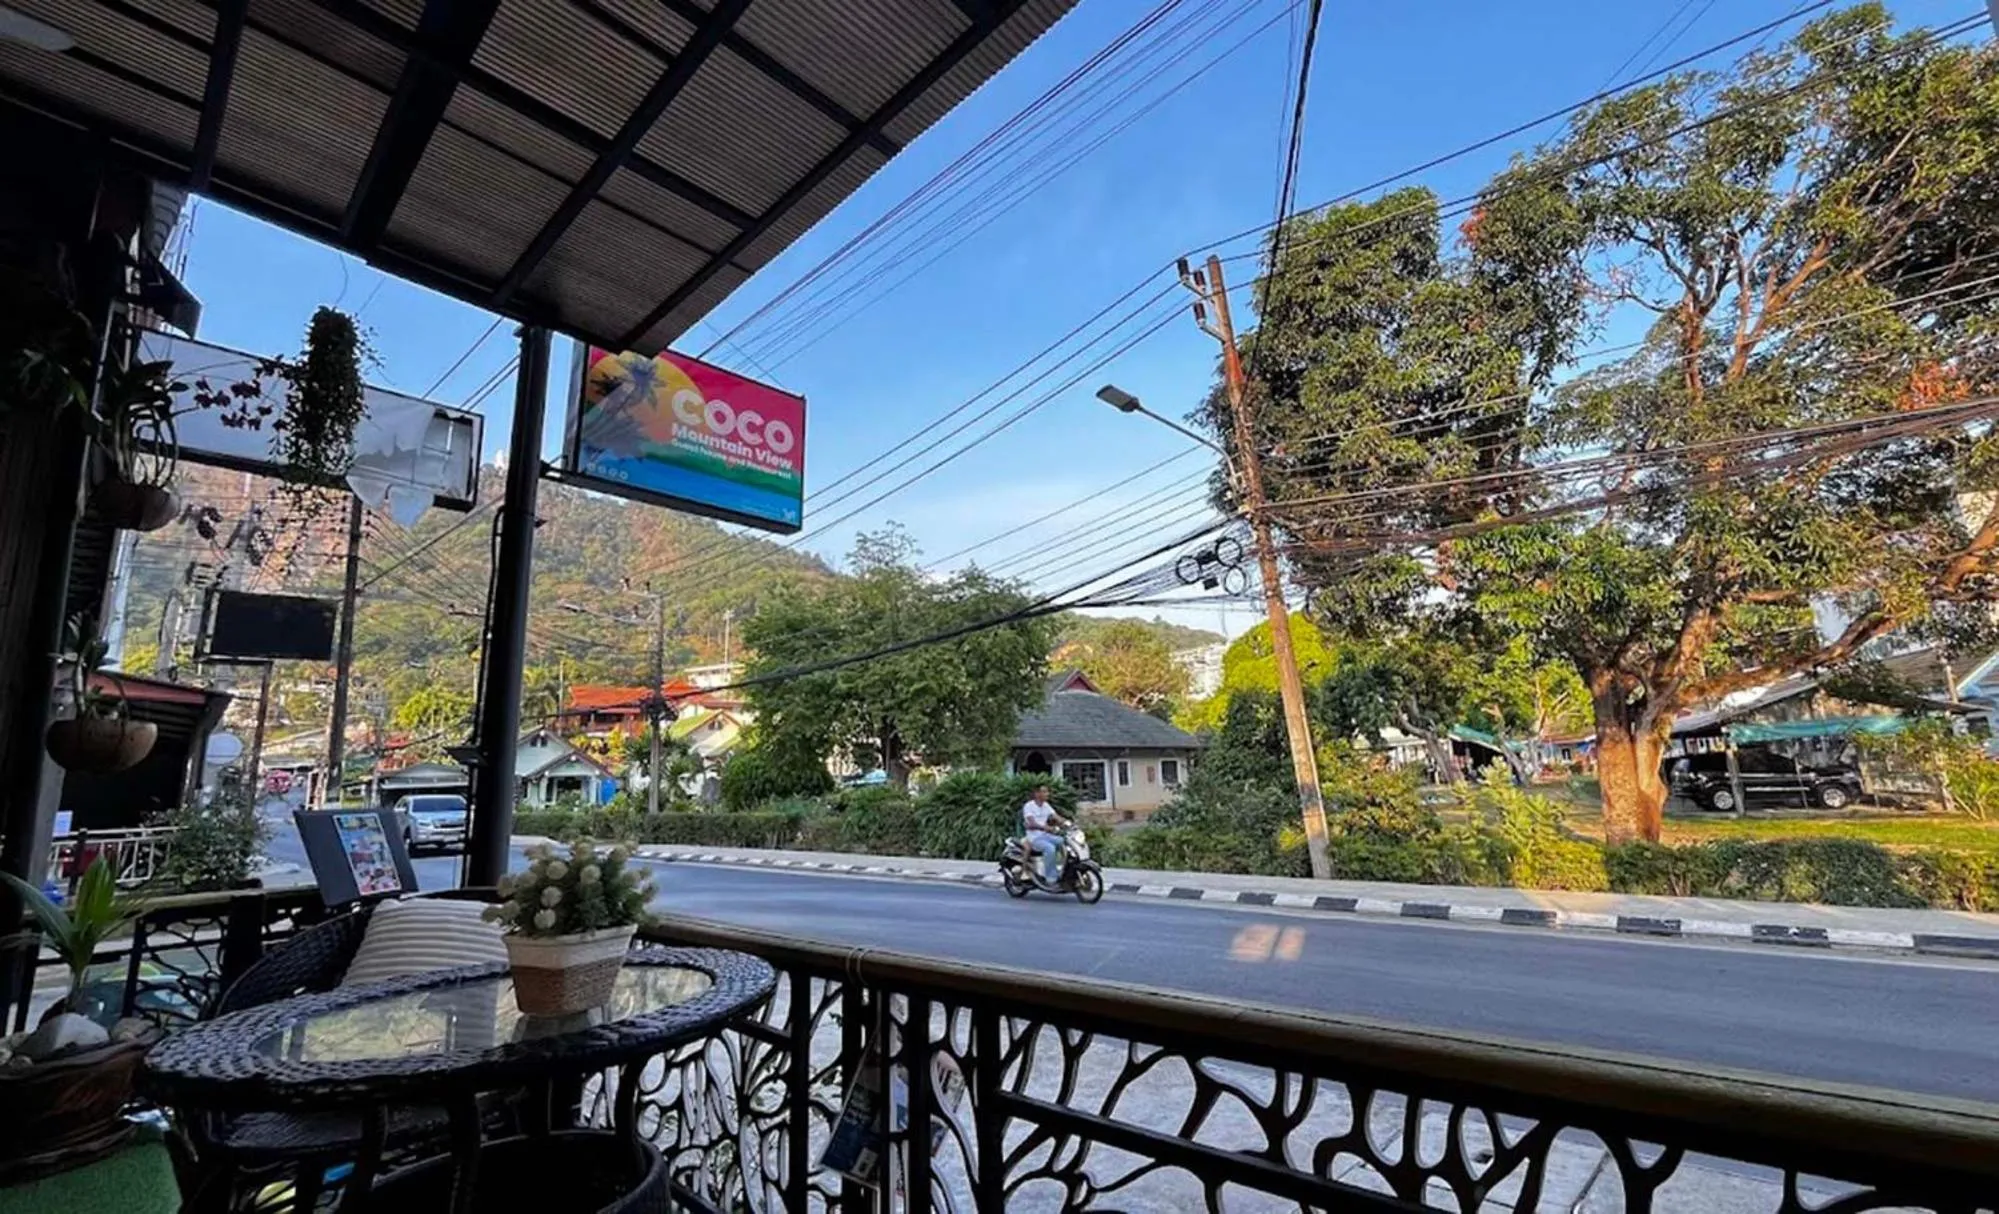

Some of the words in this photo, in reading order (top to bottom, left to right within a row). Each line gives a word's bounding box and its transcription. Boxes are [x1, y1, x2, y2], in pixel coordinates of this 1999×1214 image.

[671, 389, 794, 454] COCO
[672, 422, 753, 459] Mountain
[754, 447, 793, 470] View
